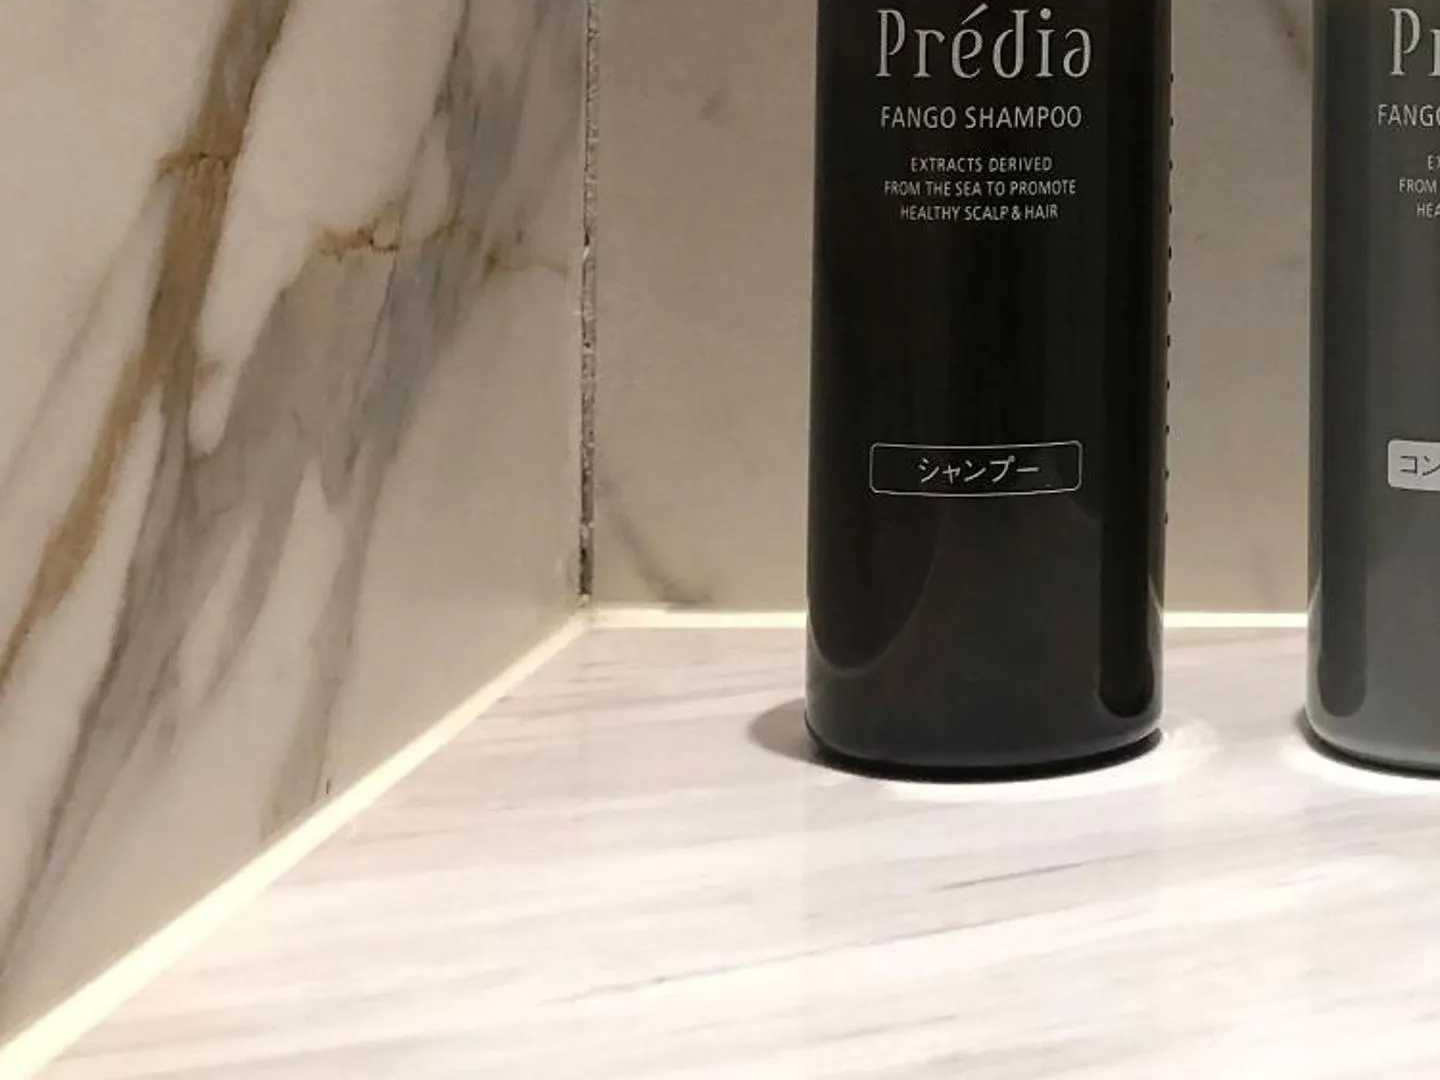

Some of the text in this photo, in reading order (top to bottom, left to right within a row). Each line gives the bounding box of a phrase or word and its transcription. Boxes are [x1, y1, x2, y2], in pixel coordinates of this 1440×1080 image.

[875, 2, 1092, 79] Prédia
[880, 105, 1082, 129] FANGO SHAMPOO
[911, 156, 1053, 172] EXTRACTS DERIVED
[885, 179, 1076, 196] FROM THE SEA TO PROMOTE
[1399, 178, 1437, 194] FROM
[901, 205, 961, 221] HEALTHY
[964, 205, 1008, 221] SCALP
[1024, 204, 1058, 219] HAIR
[918, 455, 1039, 484] シャンプー
